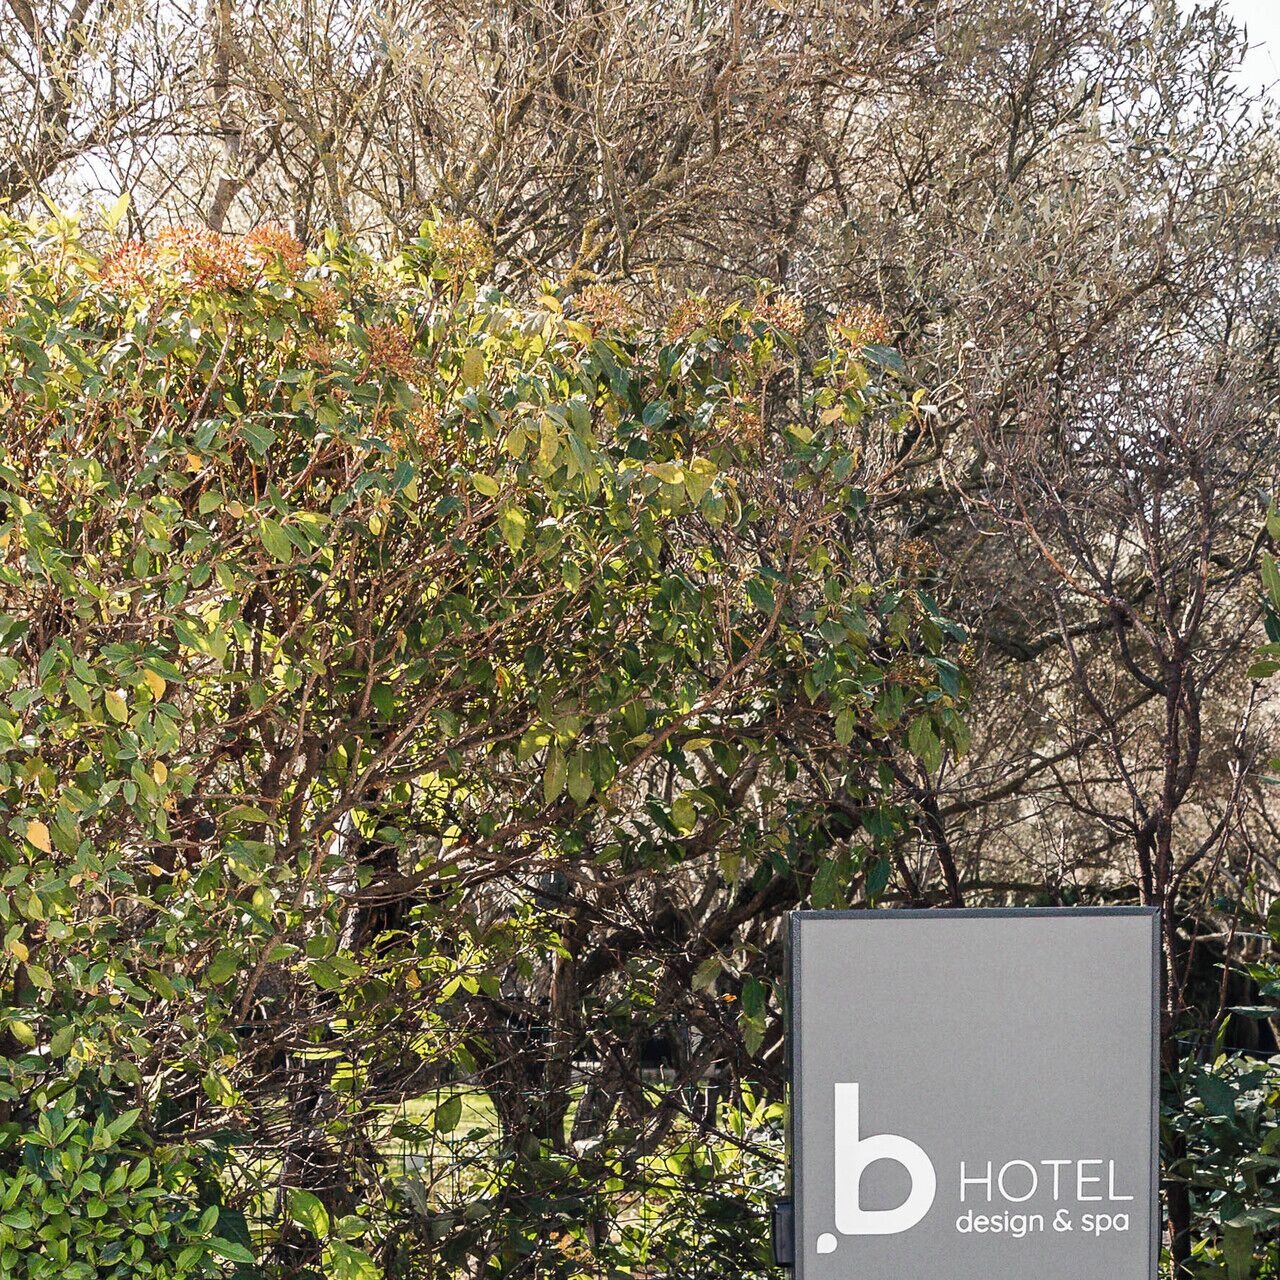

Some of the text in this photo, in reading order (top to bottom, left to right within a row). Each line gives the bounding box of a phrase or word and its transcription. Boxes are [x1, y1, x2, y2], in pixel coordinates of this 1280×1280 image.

[959, 1159, 1134, 1203] HOTEL
[955, 1208, 1130, 1238] design & spa
